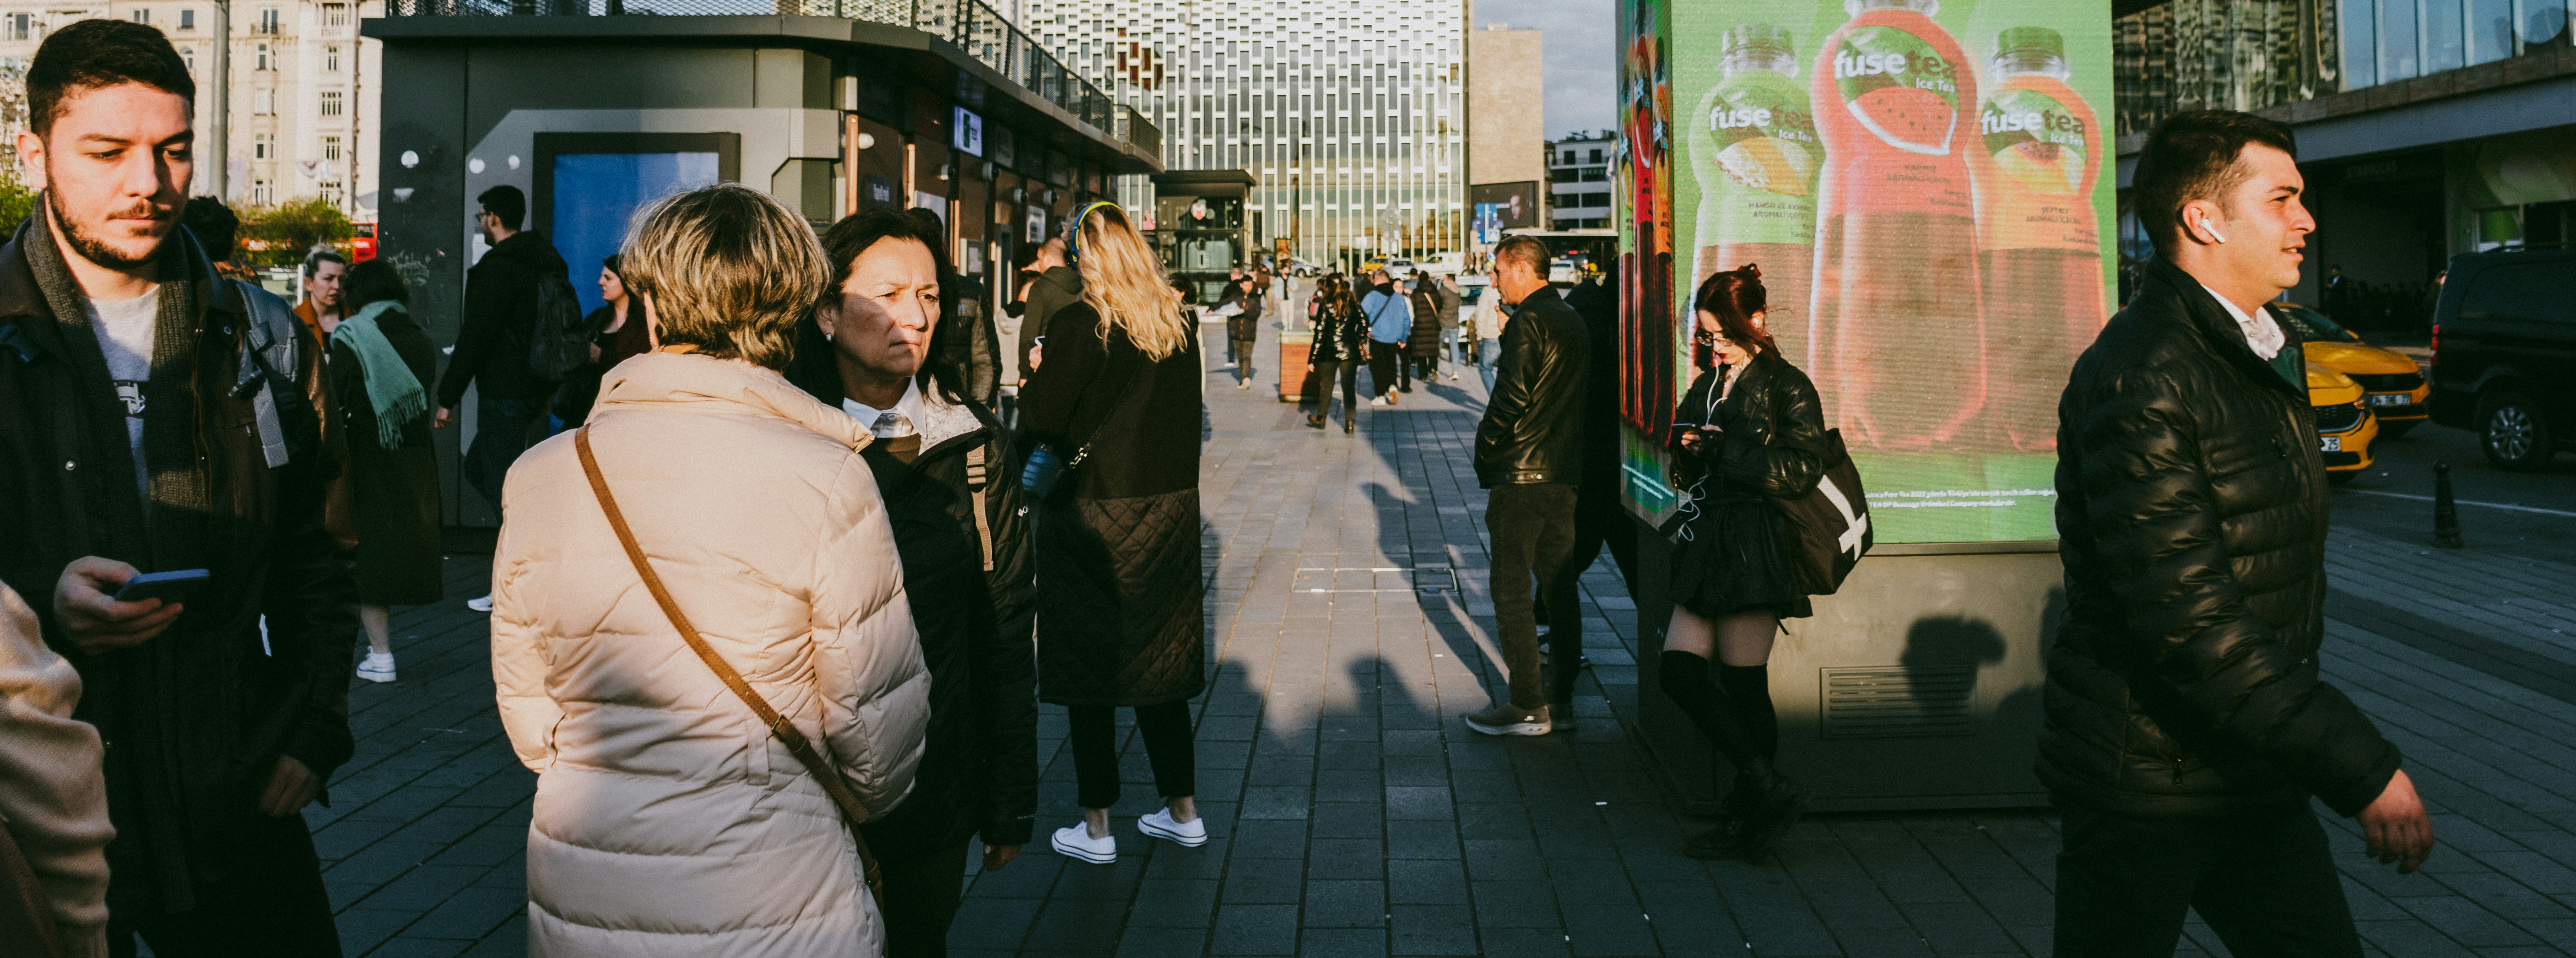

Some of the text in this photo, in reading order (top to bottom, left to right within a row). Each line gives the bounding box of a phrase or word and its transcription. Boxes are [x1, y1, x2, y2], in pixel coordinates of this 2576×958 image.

[1833, 49, 1957, 80] fusetea
[1915, 77, 1955, 93] Ice Tea
[1980, 109, 2086, 135] fusetea
[1778, 129, 1813, 142] Ice Tea
[2050, 133, 2084, 146] Ice Tea
